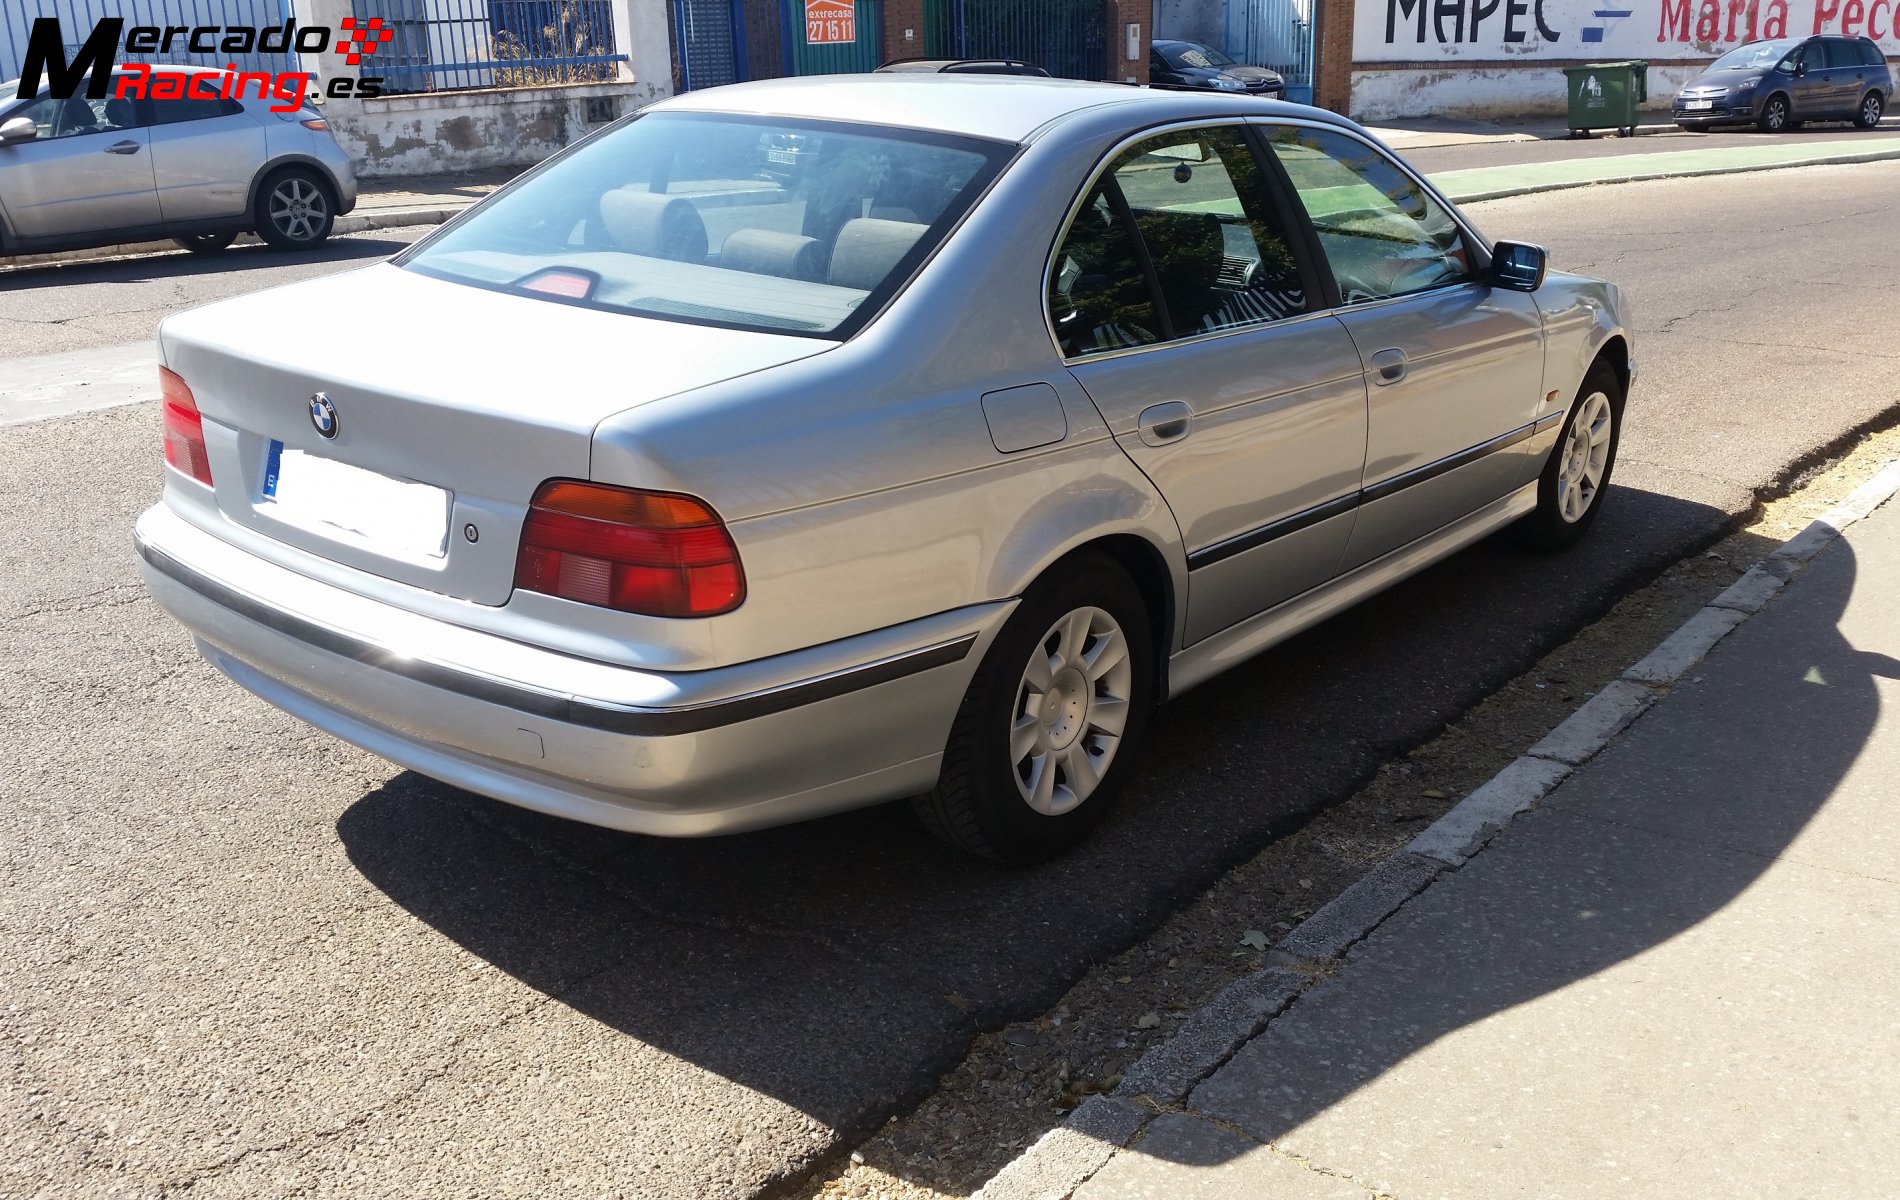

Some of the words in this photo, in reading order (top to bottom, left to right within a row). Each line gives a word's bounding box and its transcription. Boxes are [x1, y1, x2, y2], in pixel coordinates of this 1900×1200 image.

[809, 10, 852, 19] extrecasa
[1385, 0, 1561, 43] MAPEC
[1812, 0, 1900, 41] Pec
[809, 20, 824, 41] 27
[826, 20, 839, 40] 15
[841, 19, 853, 40] 11
[310, 395, 334, 412] BMW
[267, 474, 275, 488] E
